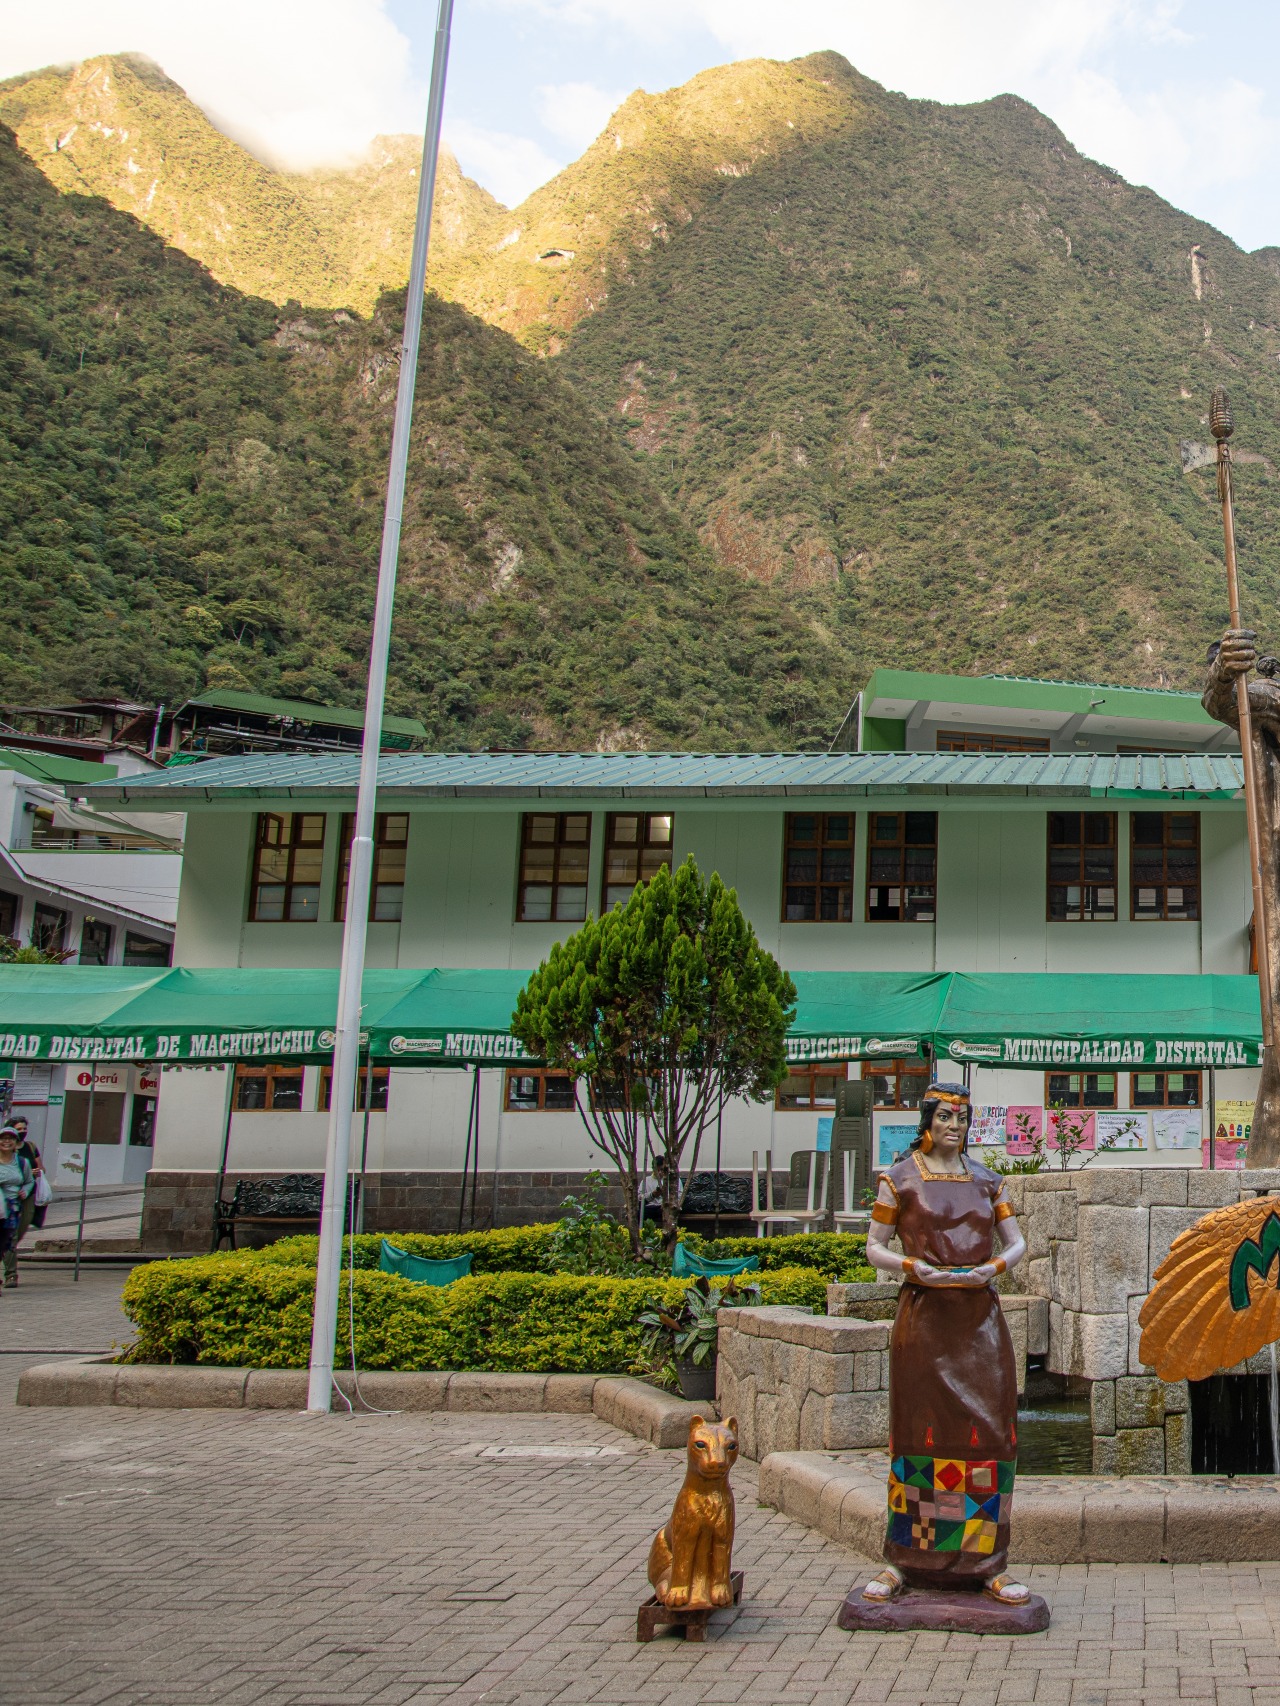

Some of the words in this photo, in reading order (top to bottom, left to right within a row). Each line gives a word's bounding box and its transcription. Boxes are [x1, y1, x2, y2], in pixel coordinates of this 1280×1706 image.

[49, 1036, 146, 1060] DISTRITAL
[156, 1036, 181, 1058] DE
[190, 1030, 315, 1057] MACHUPICCHU
[445, 1034, 548, 1057] MUNICIP
[784, 1037, 862, 1060] UPICCHU
[1004, 1039, 1145, 1063] MUNICIPALIDAD
[1155, 1042, 1247, 1064] DISTRITAL
